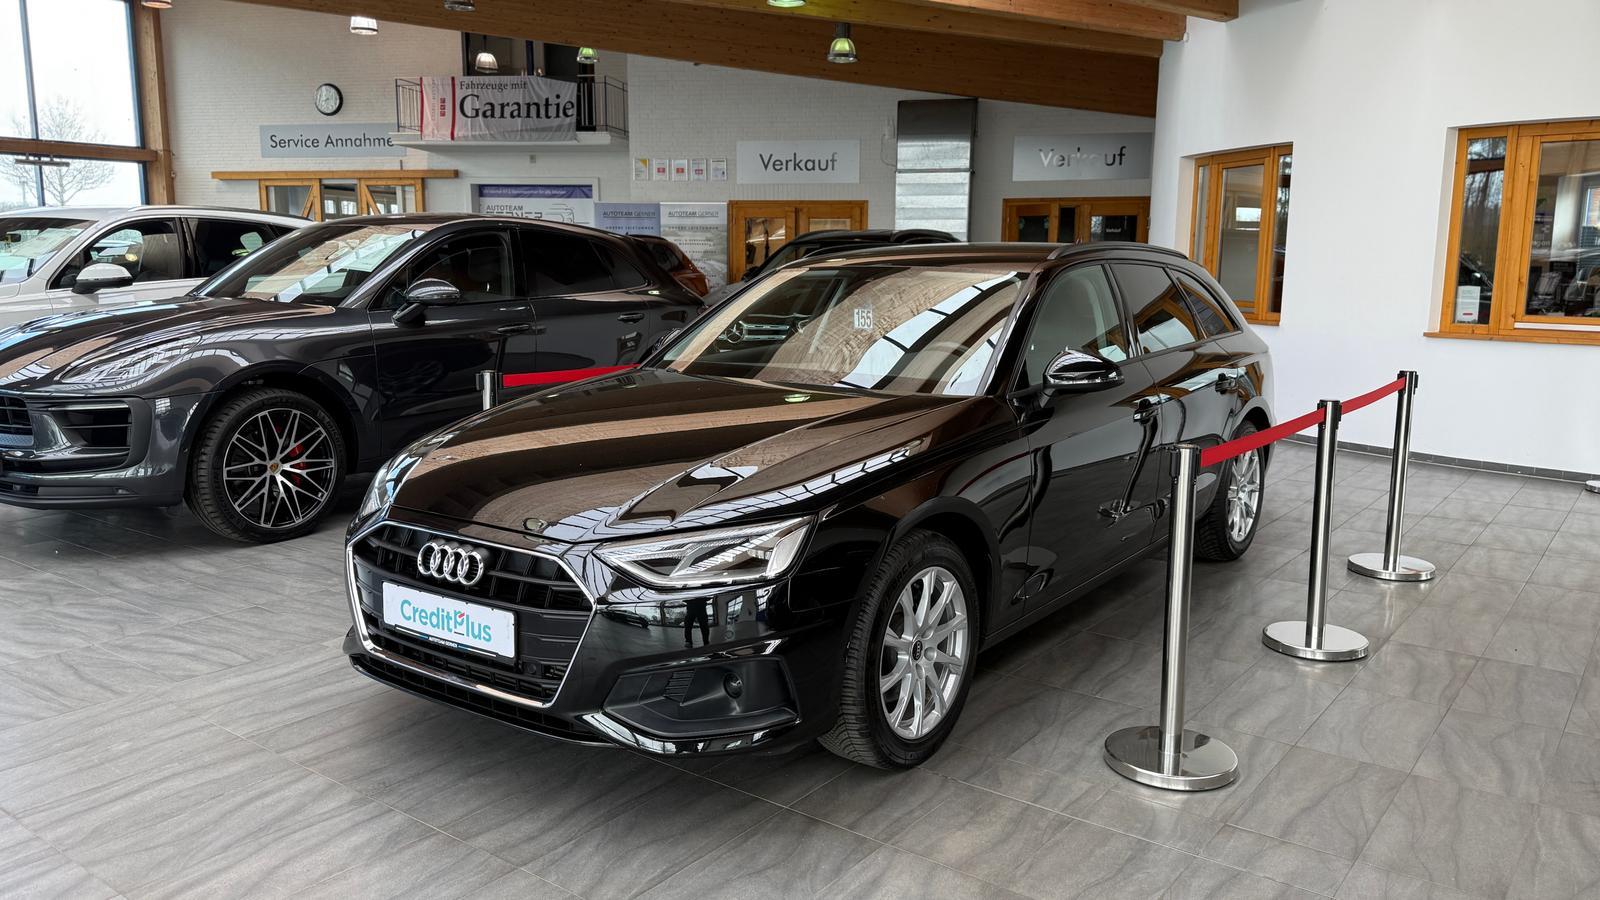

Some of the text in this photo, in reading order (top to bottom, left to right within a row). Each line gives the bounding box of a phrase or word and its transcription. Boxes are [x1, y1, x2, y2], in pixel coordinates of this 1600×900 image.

[460, 80, 527, 92] Fahrzeuge mit
[459, 93, 575, 119] Garantie
[269, 132, 394, 149] Service Annahme
[759, 152, 838, 172] Verkauf
[486, 204, 524, 212] AUTOTEAM
[855, 310, 872, 328] 155
[400, 599, 493, 643] CreditPlus
